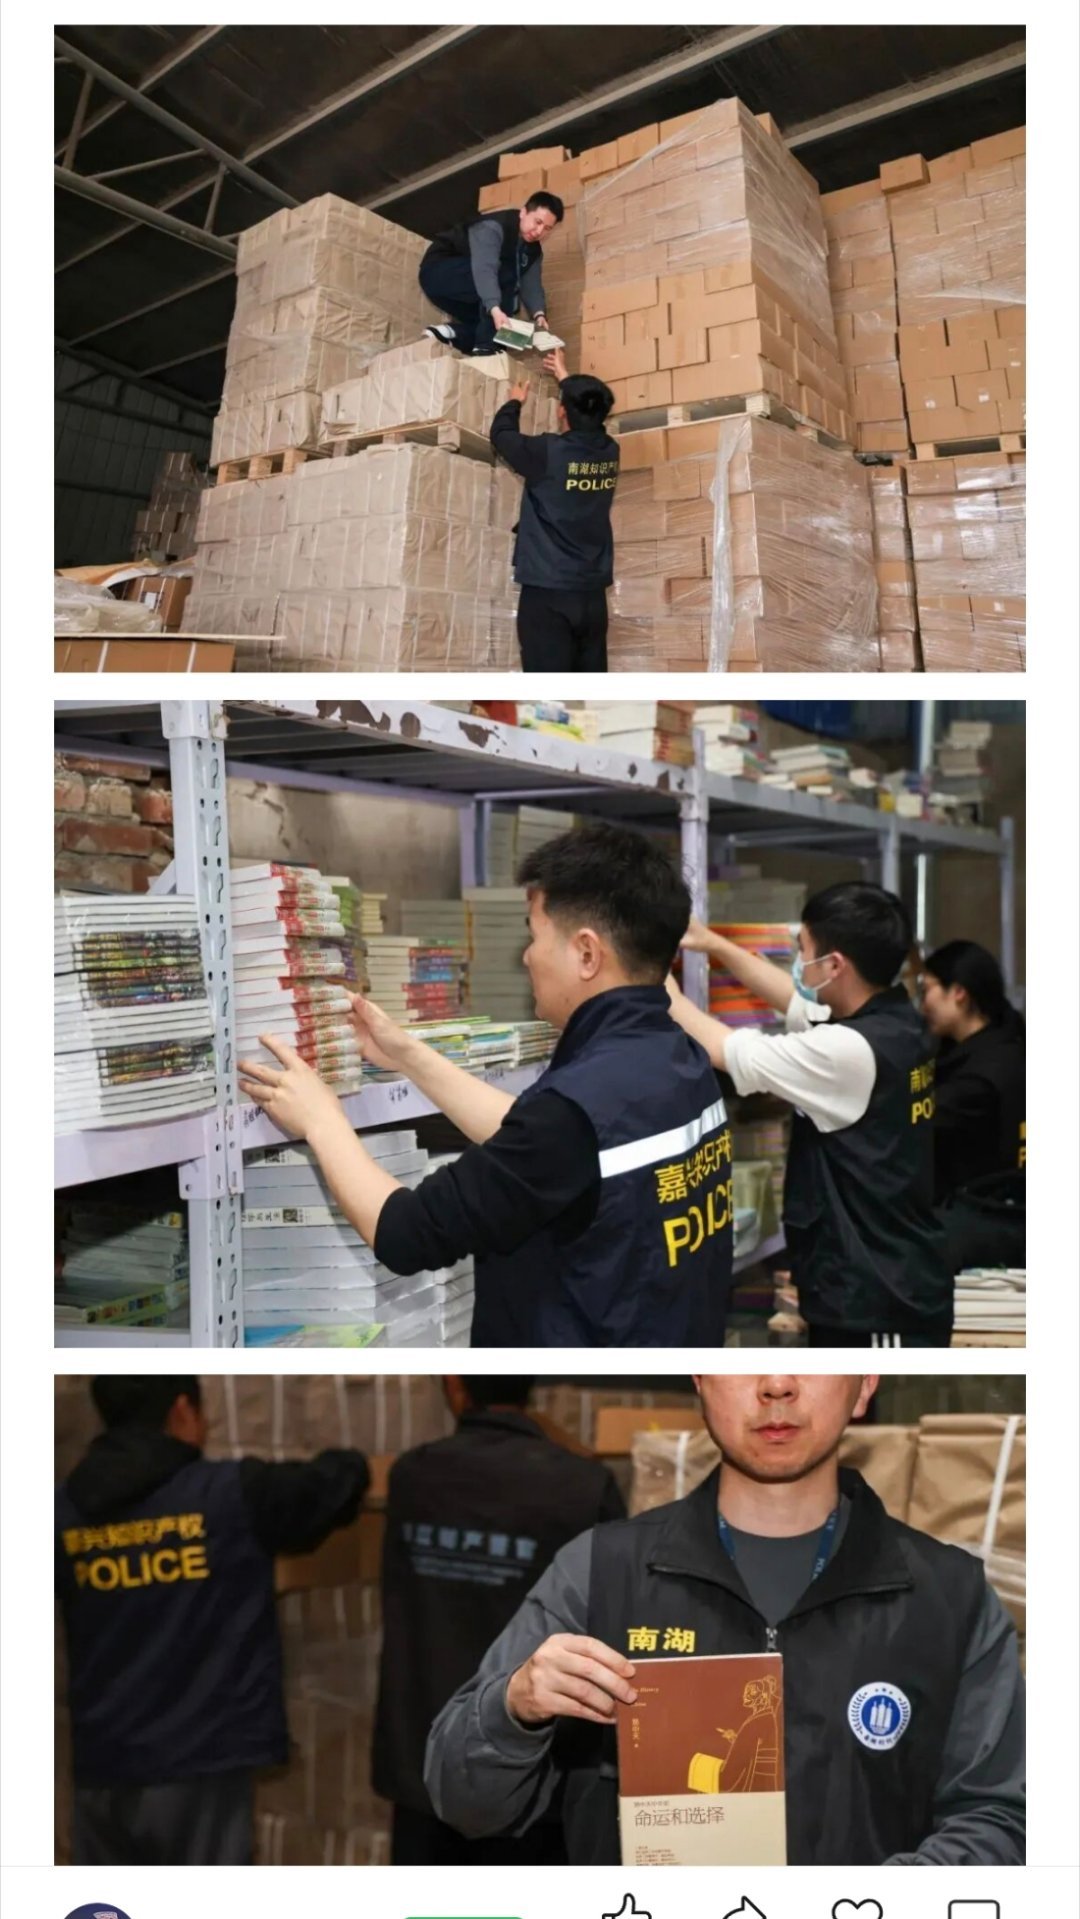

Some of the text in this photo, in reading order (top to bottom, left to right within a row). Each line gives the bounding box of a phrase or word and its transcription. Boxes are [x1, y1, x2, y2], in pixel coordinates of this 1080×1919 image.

[627, 1626, 696, 1653] 南湖
[634, 1807, 725, 1826] 命运和选择
